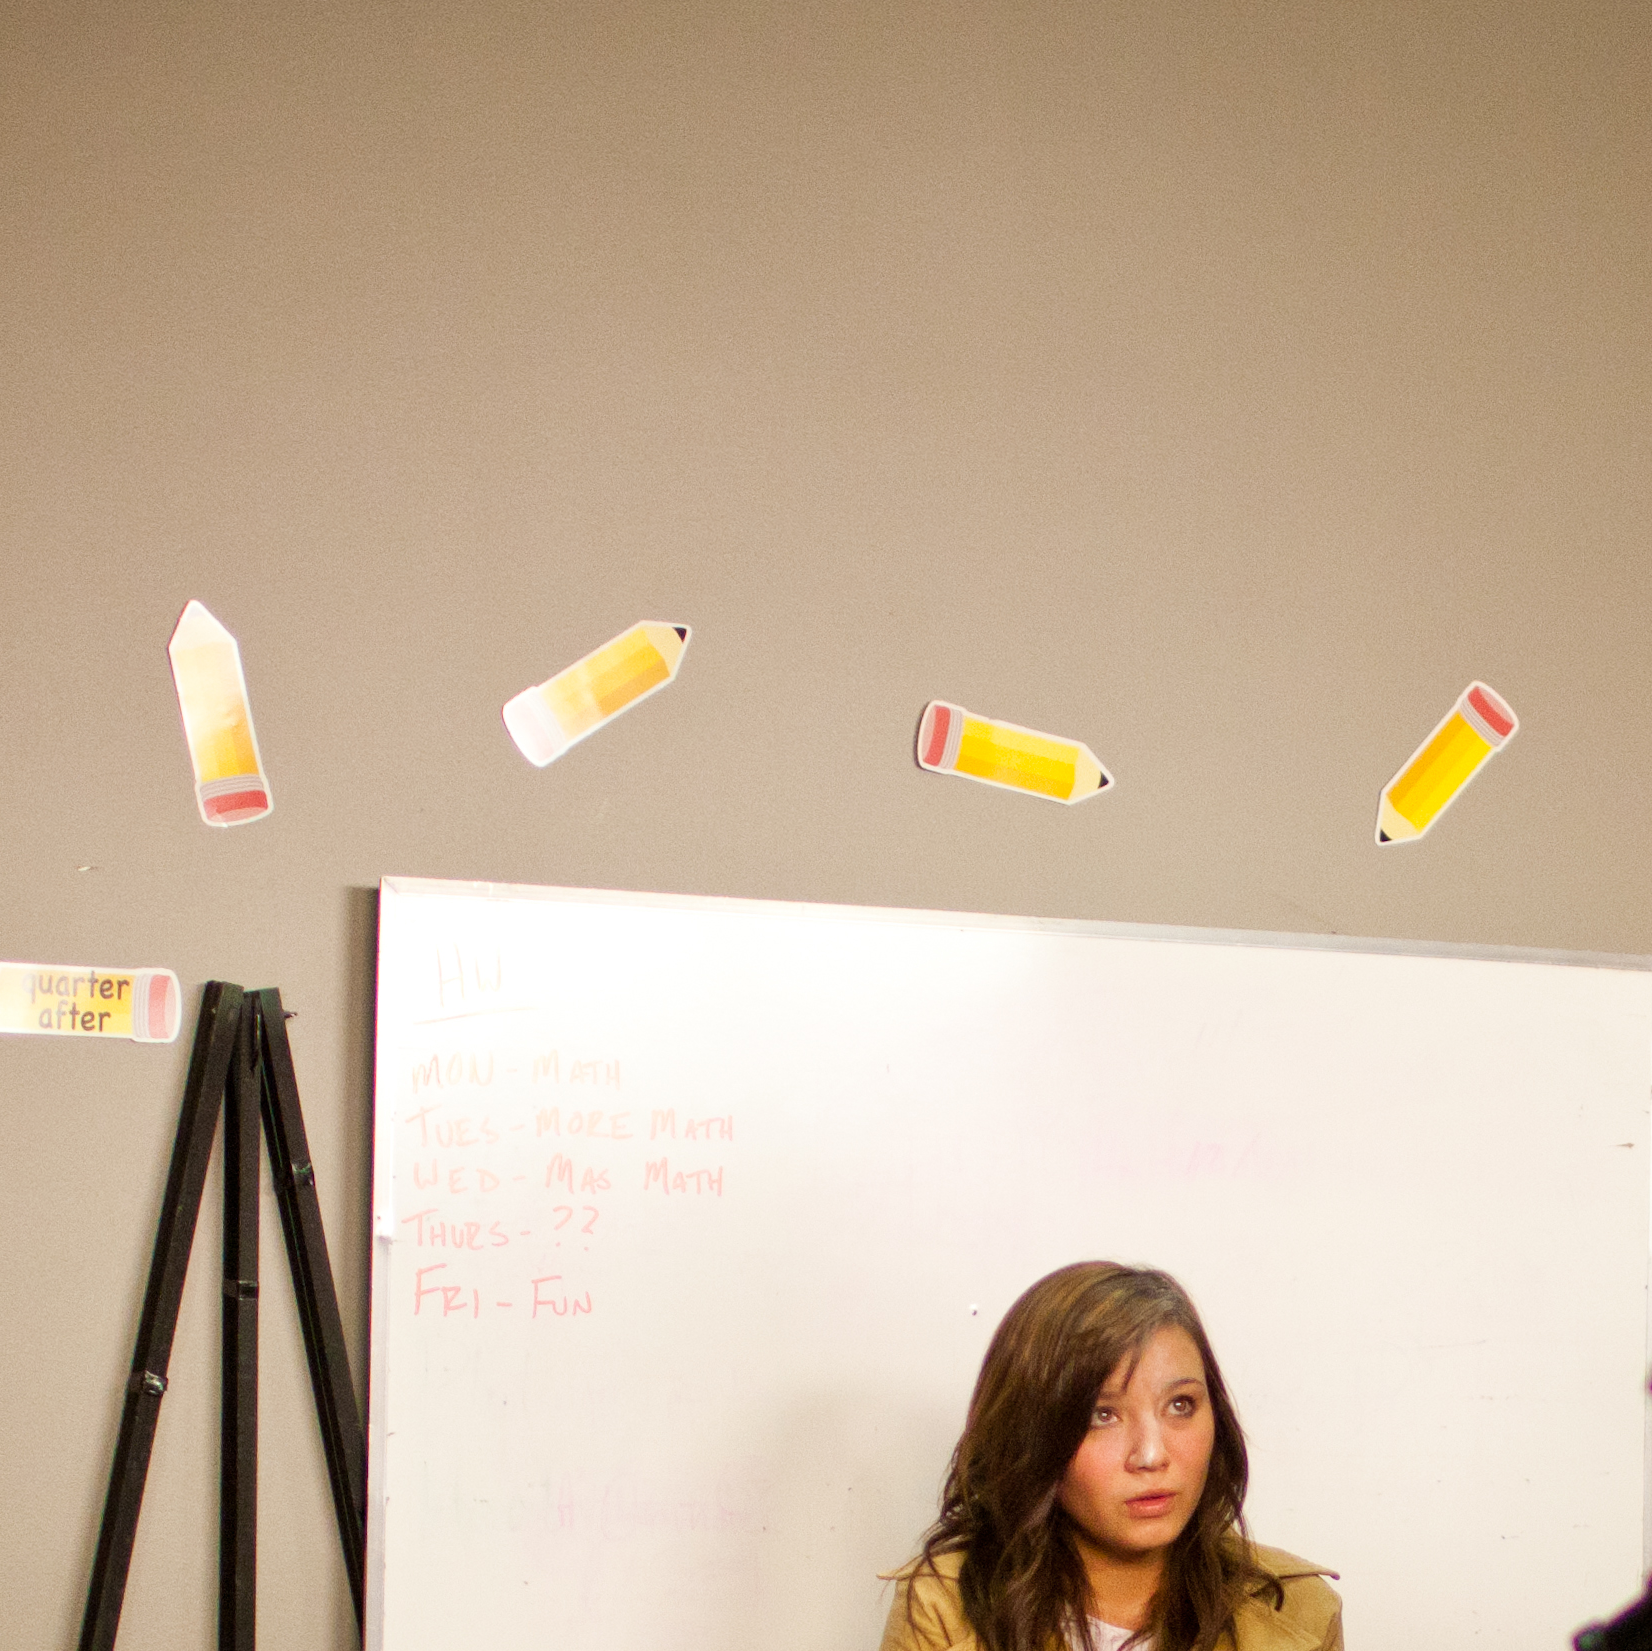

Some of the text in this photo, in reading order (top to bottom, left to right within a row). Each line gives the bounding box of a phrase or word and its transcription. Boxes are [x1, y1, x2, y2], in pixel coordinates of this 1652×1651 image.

[22, 971, 131, 1007] quarter
[38, 1001, 112, 1034] after
[532, 1049, 622, 1090] MATH
[535, 1108, 634, 1141] MORE
[650, 1107, 734, 1142] MATH
[414, 1159, 501, 1195] WED
[644, 1157, 724, 1197] MATH
[401, 1206, 510, 1252] THURS
[413, 1262, 480, 1320] FRI
[531, 1275, 594, 1320] FUN
